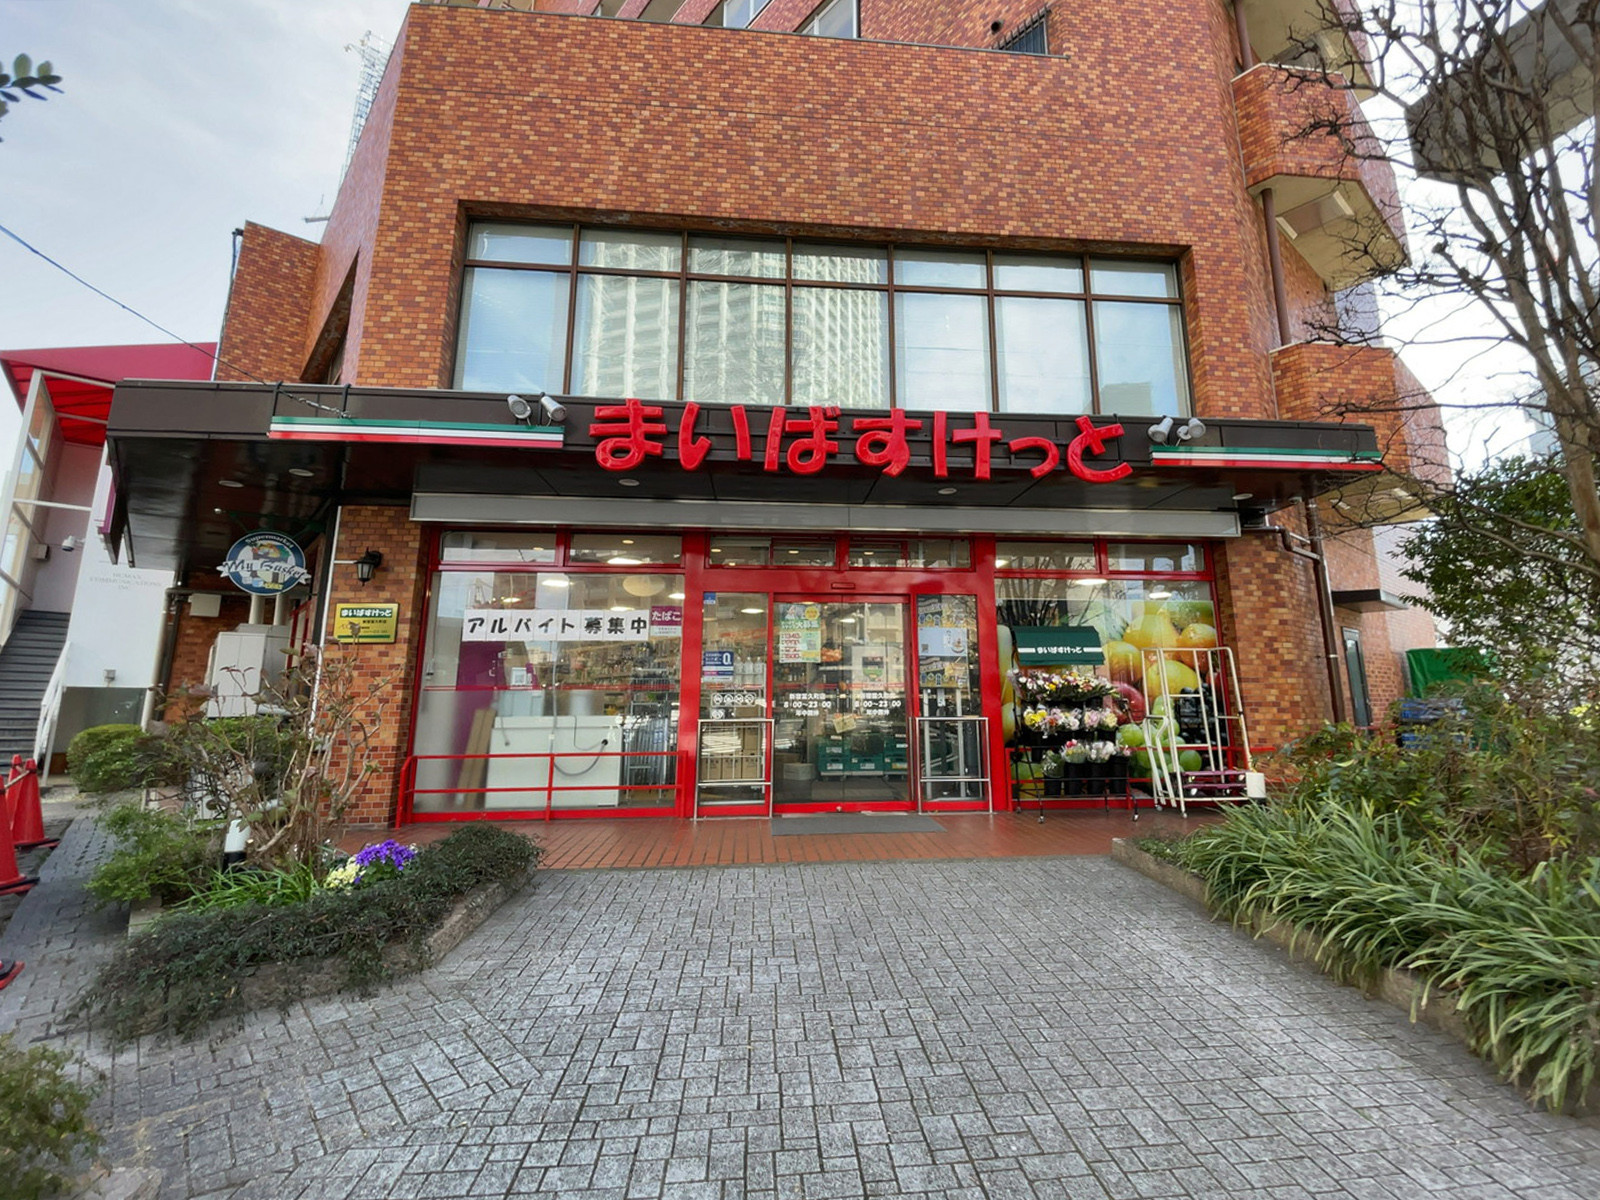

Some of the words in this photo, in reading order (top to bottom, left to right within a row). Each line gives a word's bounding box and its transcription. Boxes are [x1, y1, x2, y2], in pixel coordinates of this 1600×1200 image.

[589, 398, 1133, 483] まいばすけっと
[244, 534, 294, 549] Supermarket
[222, 559, 253, 573] My
[260, 560, 307, 580] Basket
[341, 609, 392, 617] まいばすけっと
[652, 611, 681, 621] たばこ
[468, 617, 647, 634] アルバイト募集中
[1037, 646, 1082, 654] まいばすけっと
